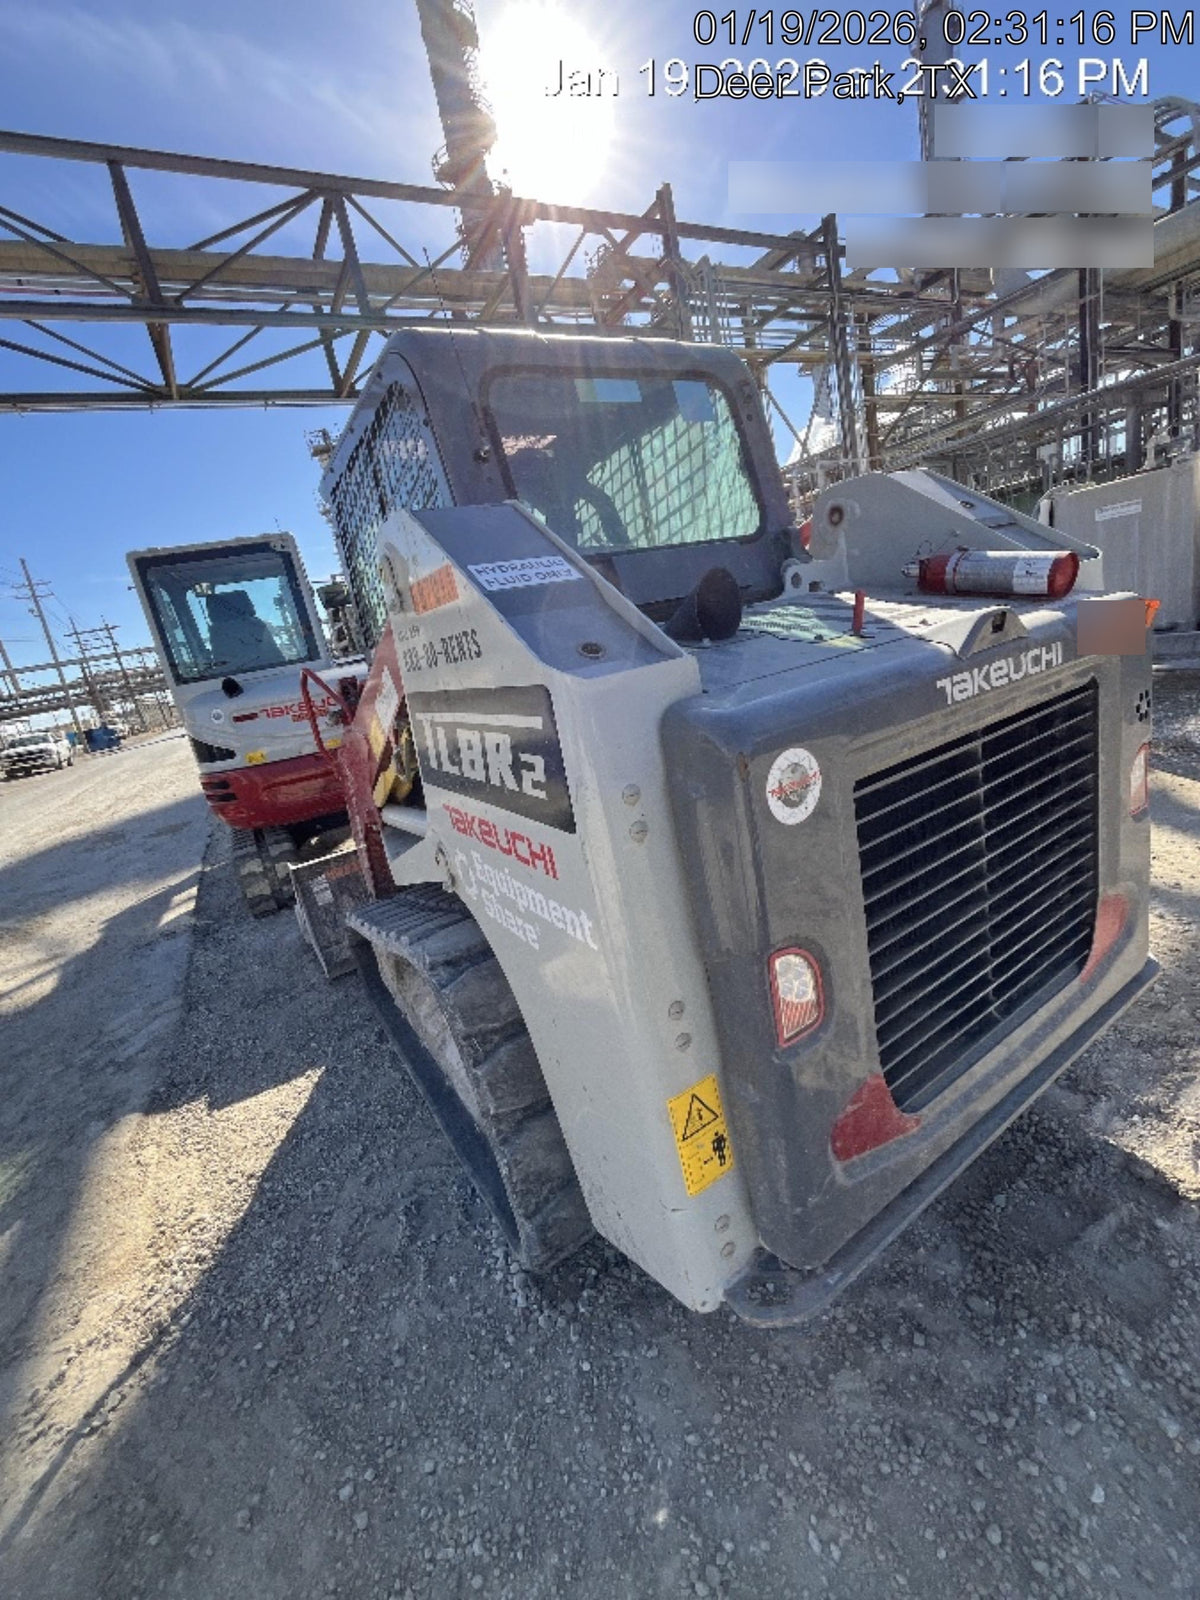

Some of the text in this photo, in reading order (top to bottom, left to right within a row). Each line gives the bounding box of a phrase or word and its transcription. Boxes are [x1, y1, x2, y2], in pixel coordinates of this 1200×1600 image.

[936, 641, 1063, 705] TAKEUCHI
[470, 849, 599, 951] Equipment
[481, 887, 541, 951] Share
